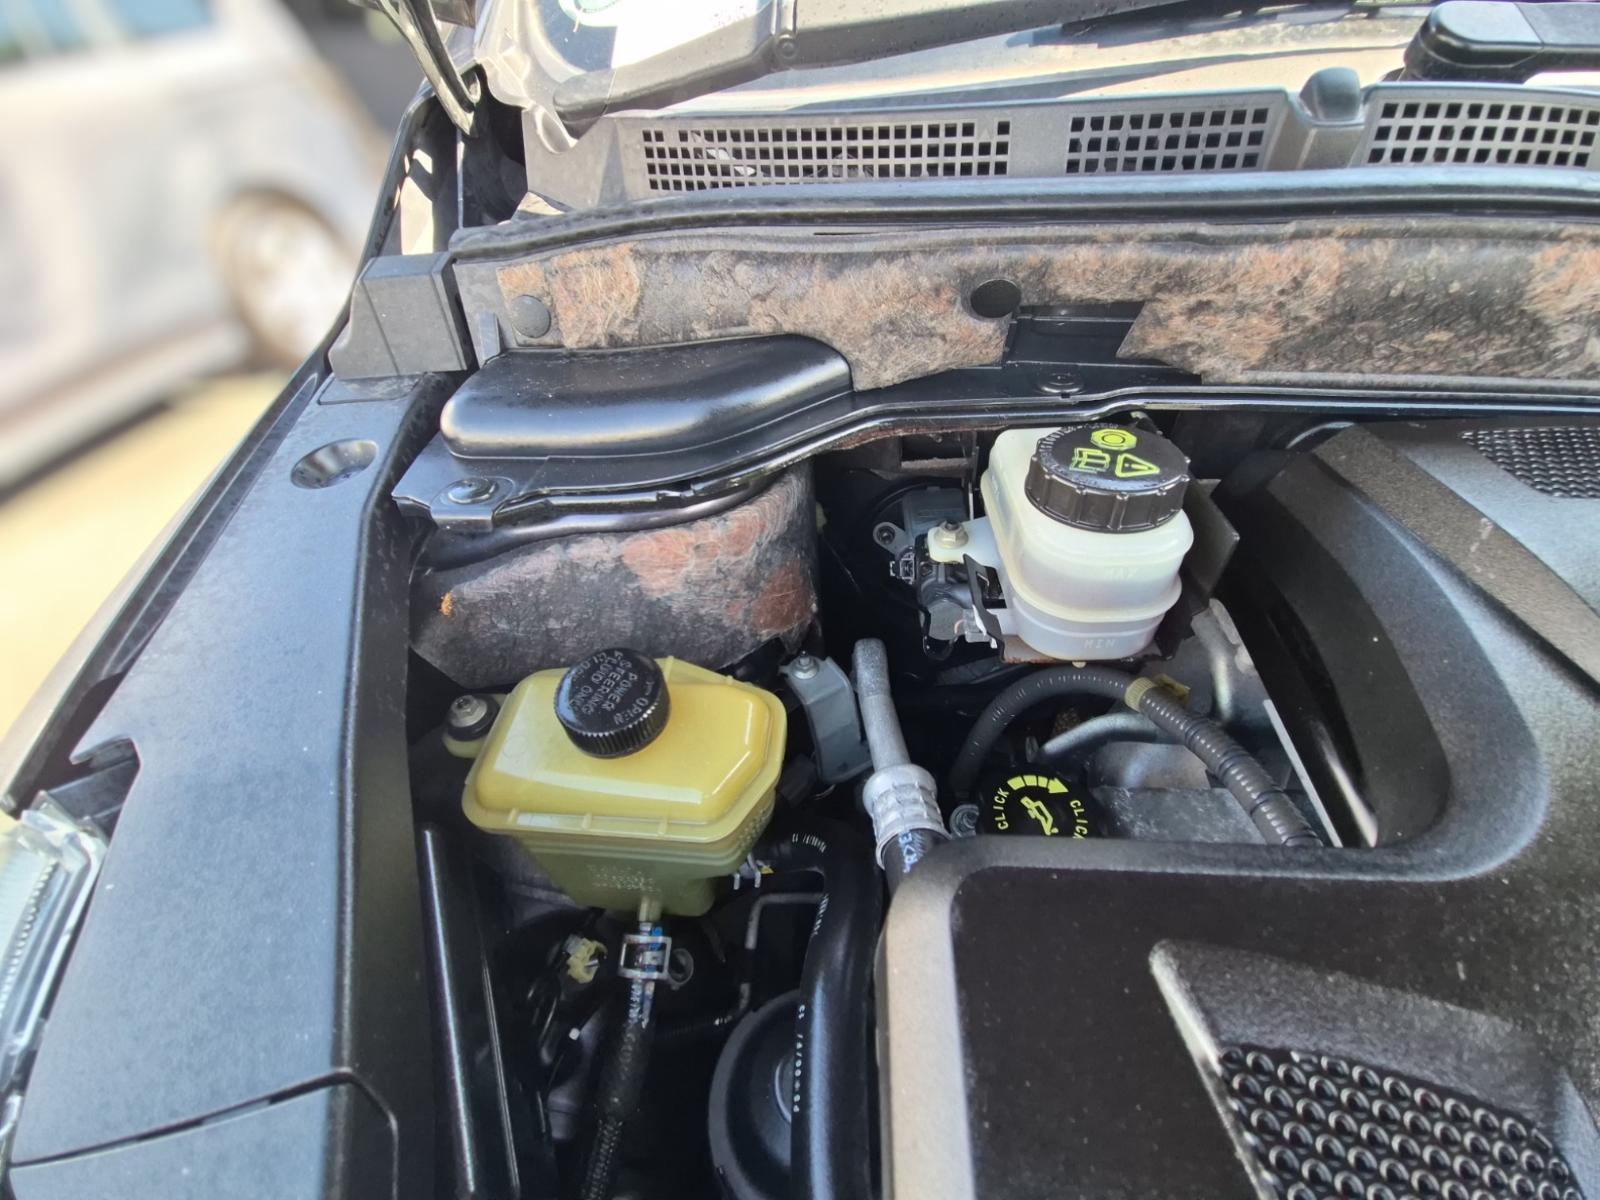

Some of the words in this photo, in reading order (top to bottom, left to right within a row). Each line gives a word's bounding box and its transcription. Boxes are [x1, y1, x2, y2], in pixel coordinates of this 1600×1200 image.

[1083, 638, 1116, 649] MIN
[591, 650, 624, 684] FLUID
[581, 660, 632, 715] STEERING
[601, 672, 638, 711] POWER
[614, 697, 649, 725] OPEN
[993, 787, 1009, 830] CLICK
[1070, 800, 1088, 839] CLICK
